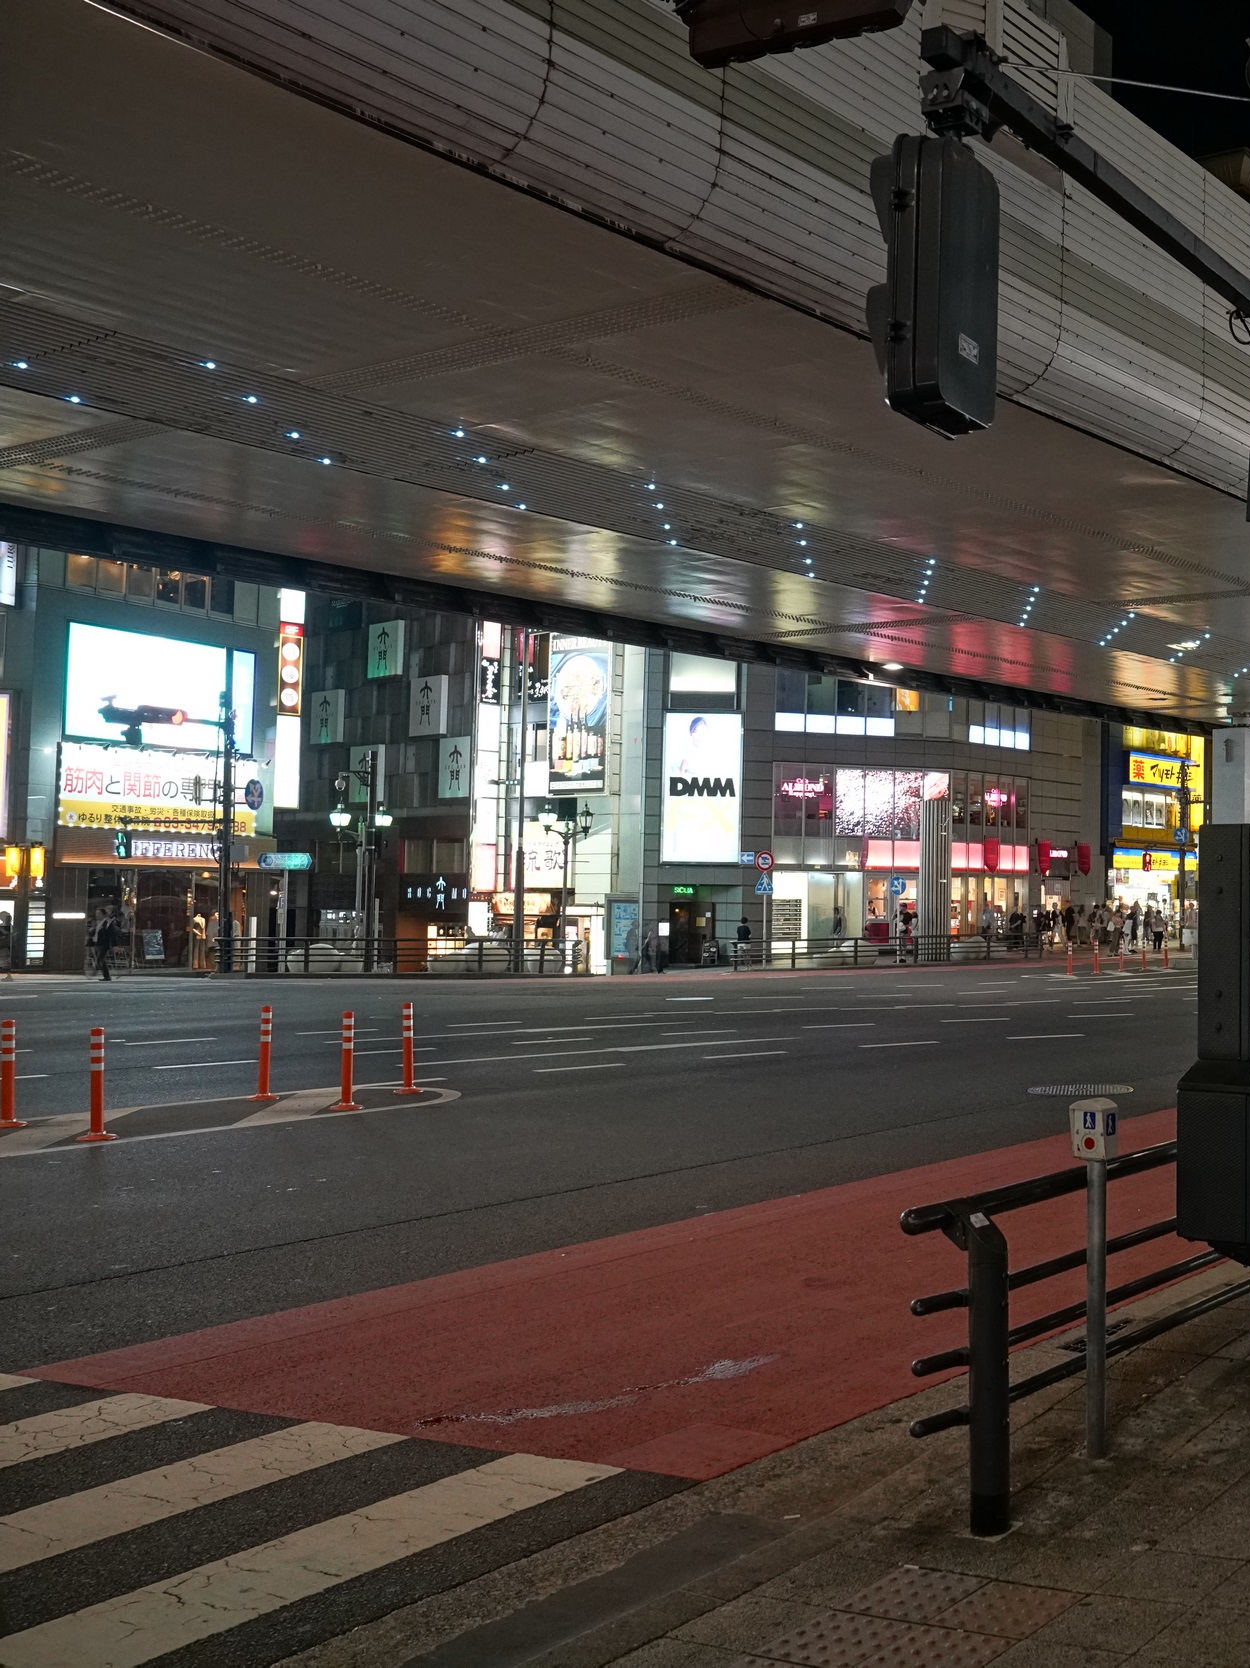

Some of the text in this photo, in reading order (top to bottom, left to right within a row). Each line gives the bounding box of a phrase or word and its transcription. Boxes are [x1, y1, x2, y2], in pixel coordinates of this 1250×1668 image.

[1133, 759, 1145, 780] 薬
[669, 776, 736, 797] DMM
[78, 812, 151, 827] ゆるり整体骨院
[118, 841, 222, 860] IFFERENC
